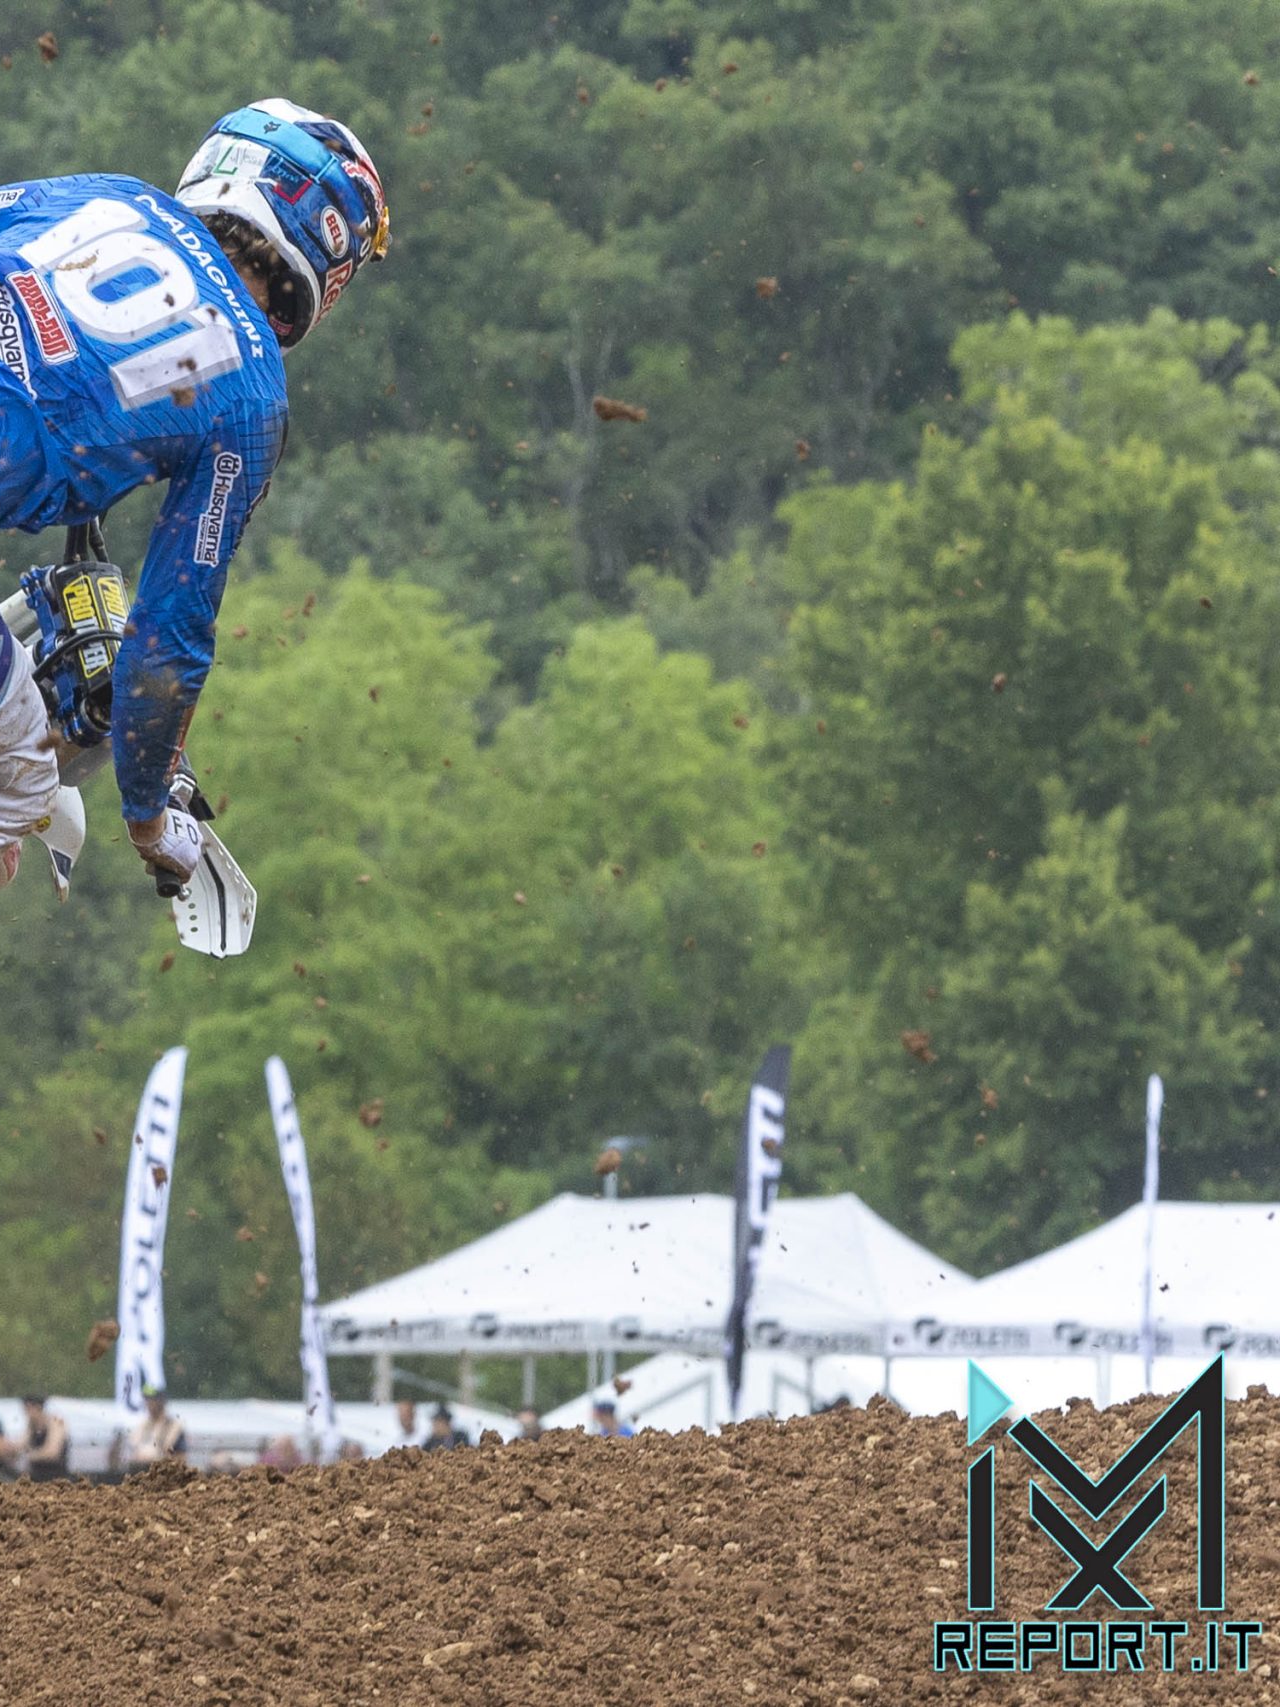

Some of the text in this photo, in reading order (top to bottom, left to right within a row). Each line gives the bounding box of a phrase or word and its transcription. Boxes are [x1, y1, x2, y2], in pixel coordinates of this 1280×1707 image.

[16, 197, 243, 411] 101
[204, 474, 230, 563] Husqvarna
[63, 581, 108, 670] PROTER
